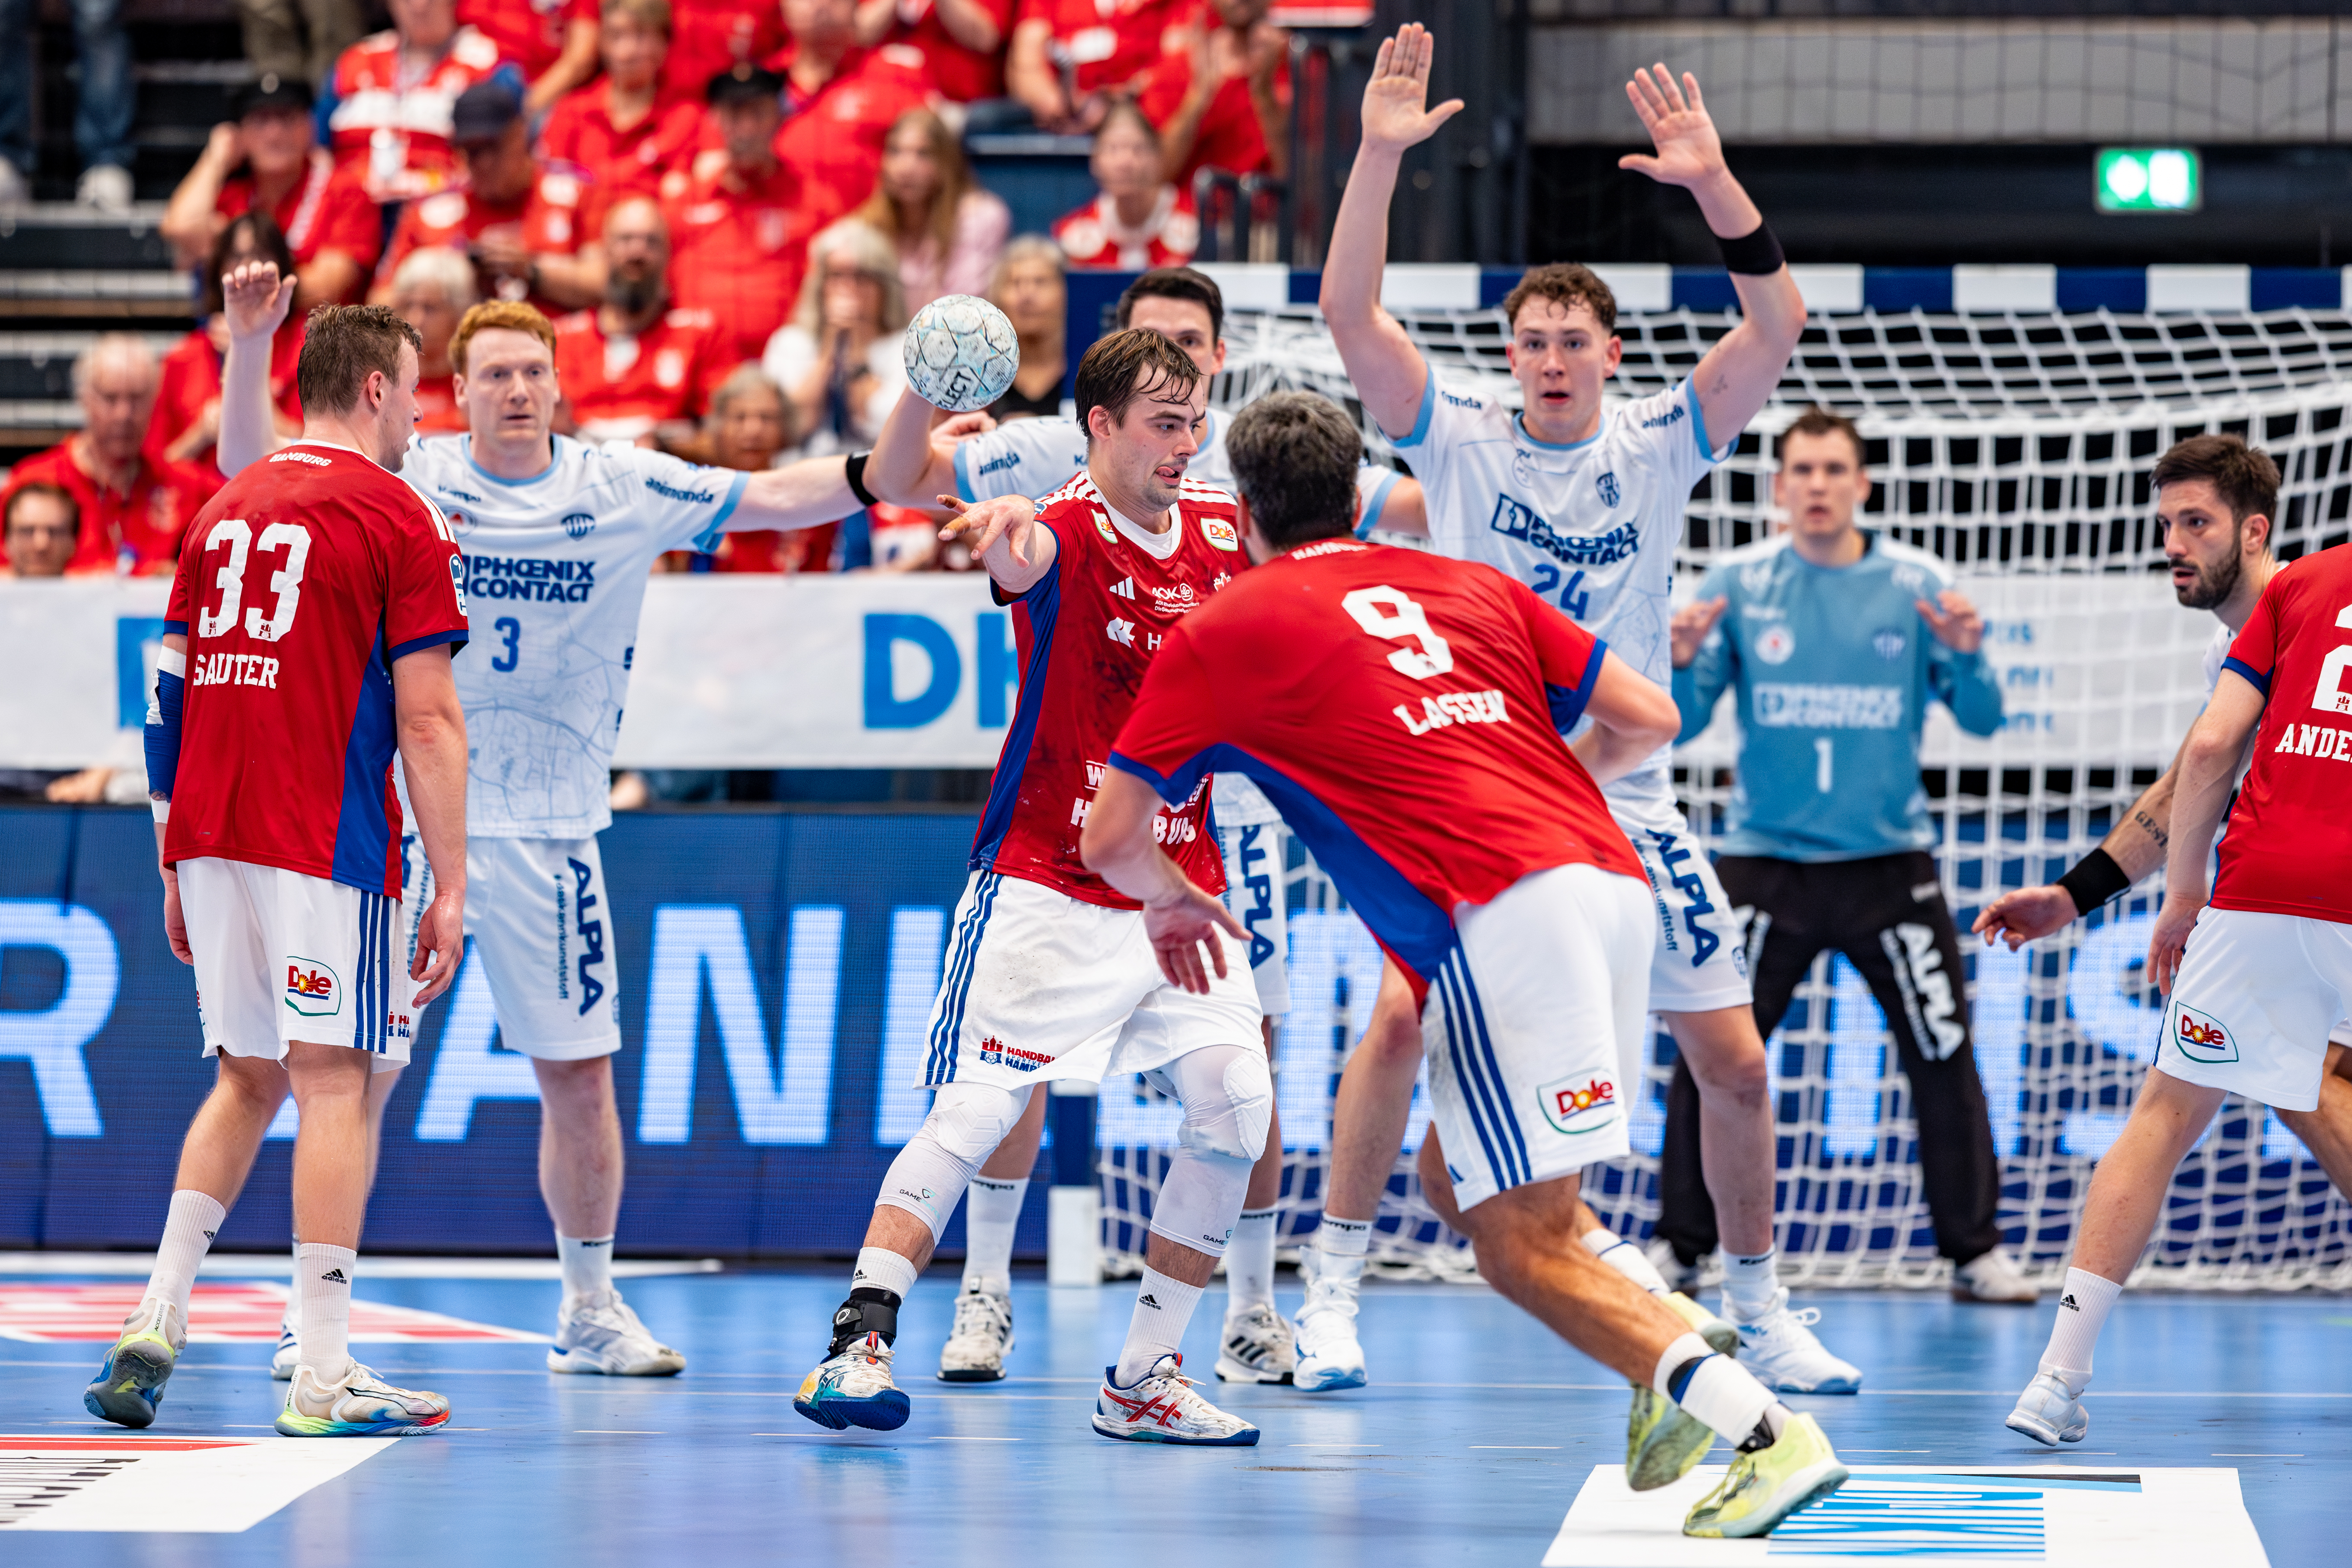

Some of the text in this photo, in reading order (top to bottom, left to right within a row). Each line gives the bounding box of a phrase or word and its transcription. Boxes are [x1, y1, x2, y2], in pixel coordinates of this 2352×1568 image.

[269, 452, 332, 467] HAMBURG
[1208, 524, 1234, 539] Dole
[1531, 533, 1639, 565] CONTACT
[198, 519, 312, 642] 33
[470, 578, 594, 603] CONTACT
[1531, 564, 1589, 620] 24
[492, 617, 520, 672] 3
[1341, 584, 1454, 680] 9
[193, 653, 279, 690] SAUTER
[1392, 690, 1511, 736] LASSEN
[2274, 723, 2352, 763] ANDE
[1814, 738, 1833, 794] 1
[288, 965, 332, 995] Dole
[2180, 1014, 2225, 1046] Dole
[1555, 1079, 1613, 1114] Dole
[321, 1274, 347, 1284] adidas
[154, 1303, 166, 1332] ACCELERATE
[287, 1374, 298, 1408] ACCELERATE
